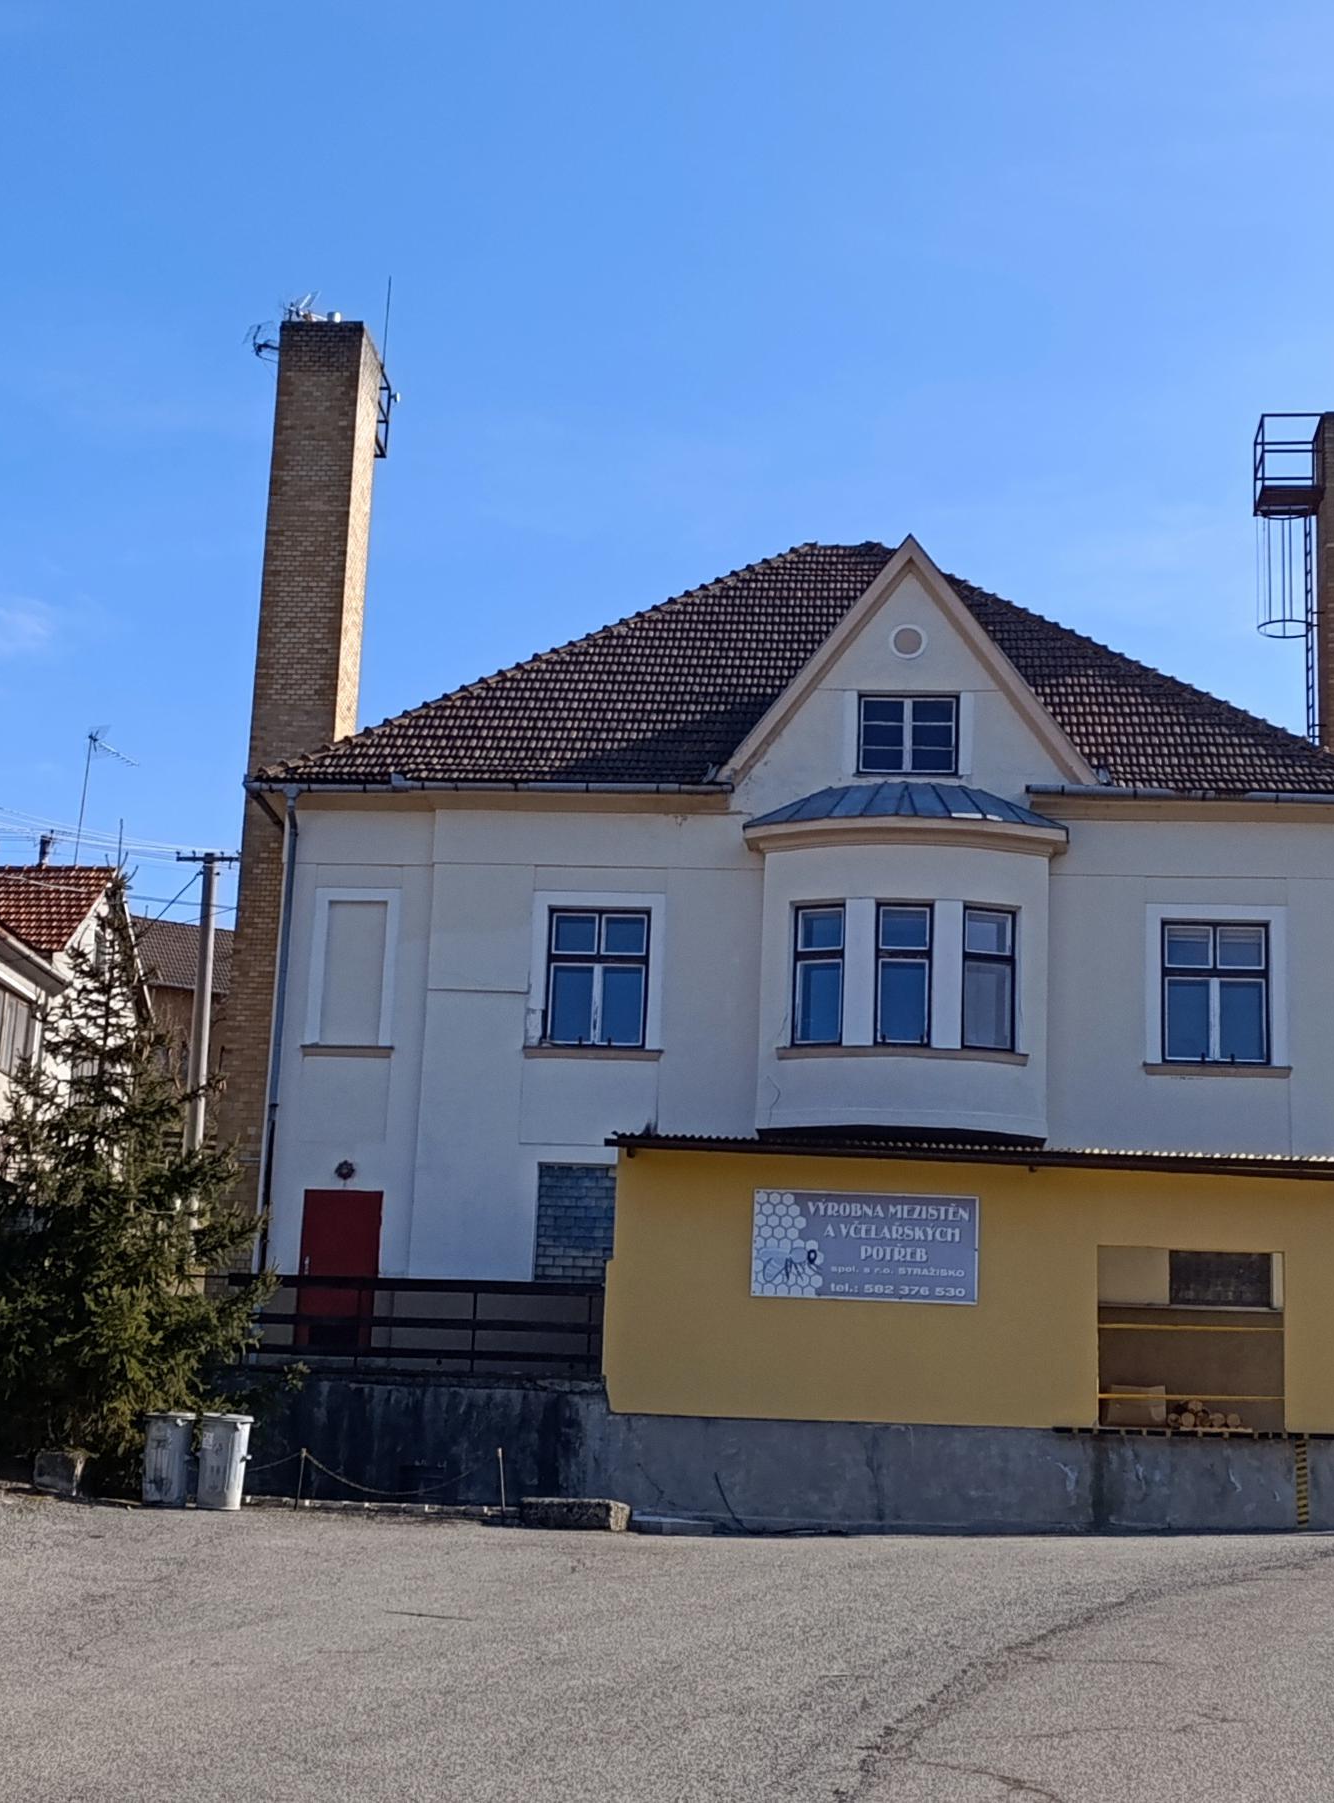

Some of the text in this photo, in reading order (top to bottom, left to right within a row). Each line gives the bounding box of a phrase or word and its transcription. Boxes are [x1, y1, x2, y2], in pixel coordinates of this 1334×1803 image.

[807, 1199, 970, 1222] VÝROBNA MEZISTĚN
[824, 1221, 961, 1242] A VČELAŘSKÝCH
[860, 1244, 928, 1262] POTŘEB
[830, 1265, 859, 1274] spol.
[874, 1267, 893, 1275] r.o.
[898, 1266, 965, 1277] STRAŽISKO
[830, 1283, 966, 1297] tel.: 582 376 530
